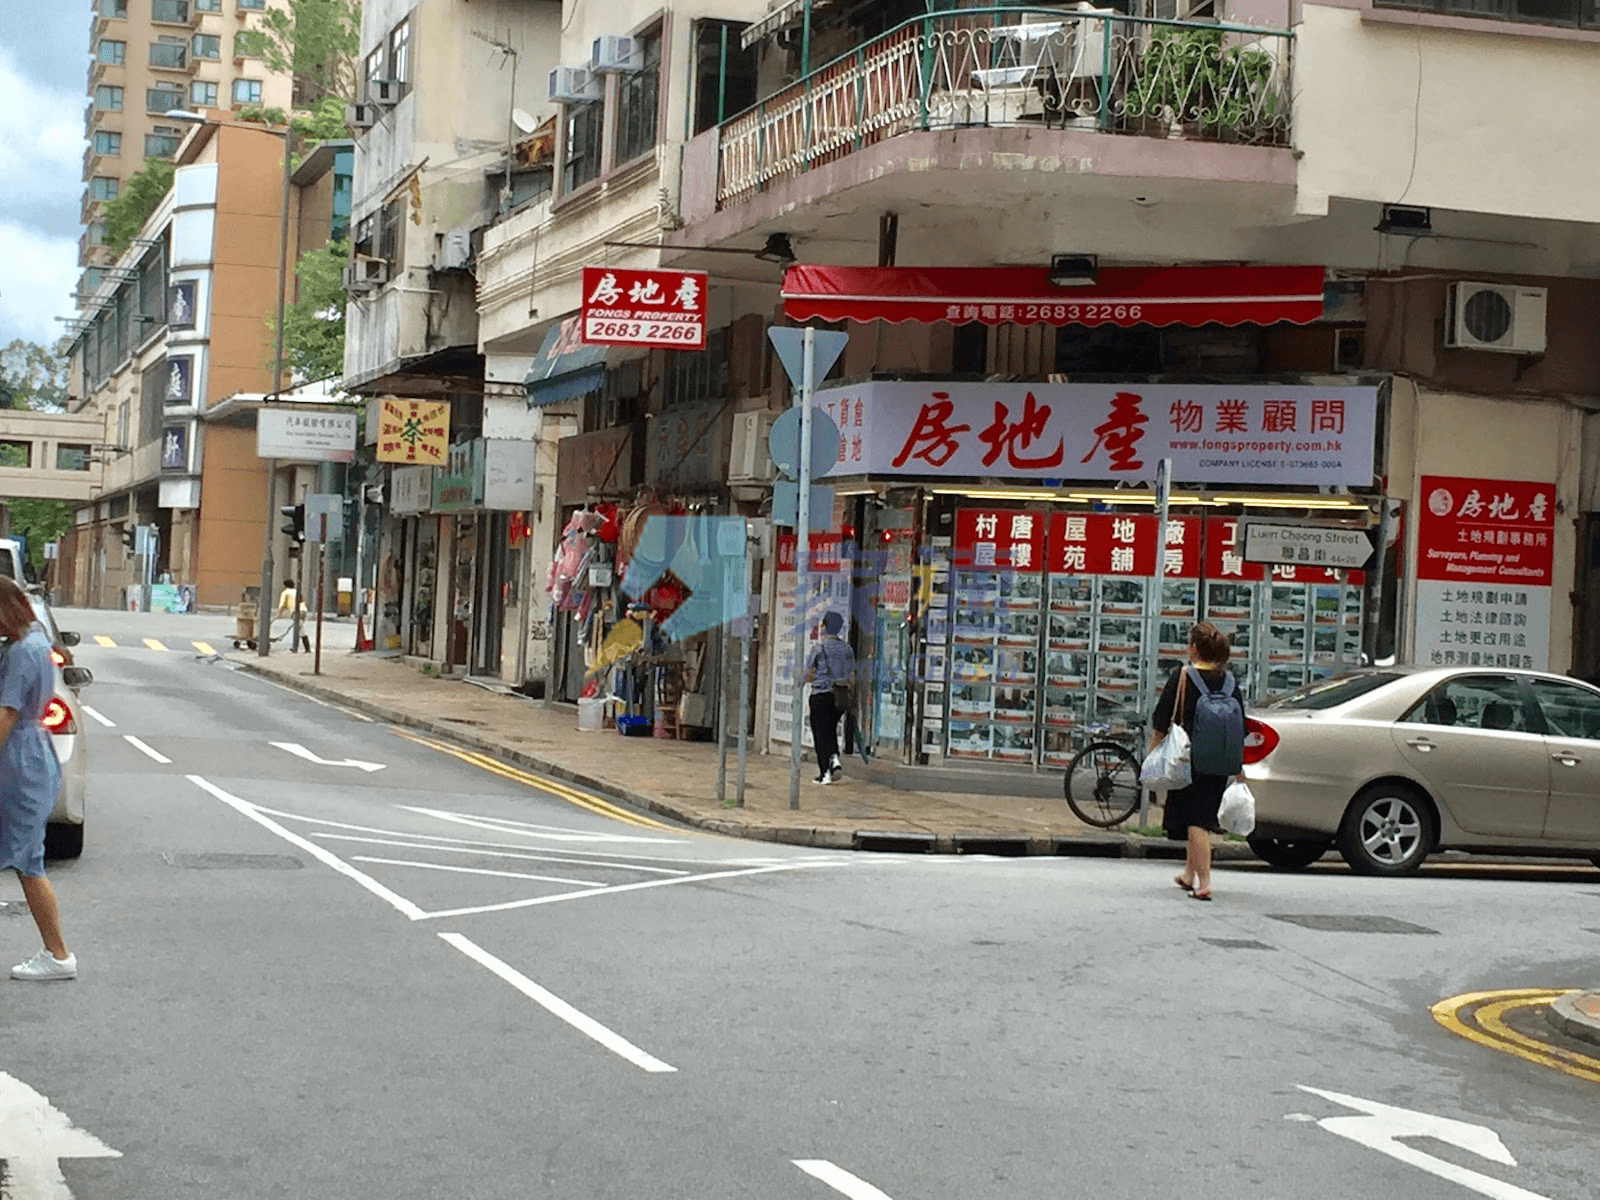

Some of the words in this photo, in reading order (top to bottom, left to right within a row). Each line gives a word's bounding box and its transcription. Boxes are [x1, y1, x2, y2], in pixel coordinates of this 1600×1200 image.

[587, 272, 700, 310] 房地產
[586, 308, 632, 319] FONGS
[633, 310, 702, 323] PROPERTY
[1026, 305, 1080, 319] 2683
[1085, 305, 1142, 319] 2266
[591, 322, 642, 338] 2683
[646, 325, 697, 341] 2266
[1168, 399, 1346, 434] 物業顧問
[400, 417, 424, 445] 茶
[891, 390, 1150, 472] 房地產
[1168, 439, 1343, 453] www.fongsproperty.com.hk
[1199, 459, 1240, 468] COMPANY
[1456, 489, 1549, 521] 房地產
[1251, 529, 1278, 540] Luen
[1281, 530, 1321, 544] Cheong
[1325, 532, 1359, 544] Street
[1469, 550, 1503, 564] Planning
[1505, 553, 1520, 563] and
[1446, 563, 1497, 576] Management
[1498, 565, 1545, 578] Consultants
[1441, 588, 1528, 606] 土地規劃申請
[1440, 610, 1528, 627] 土地法律諮詢
[1439, 630, 1527, 648] 土地更改用途
